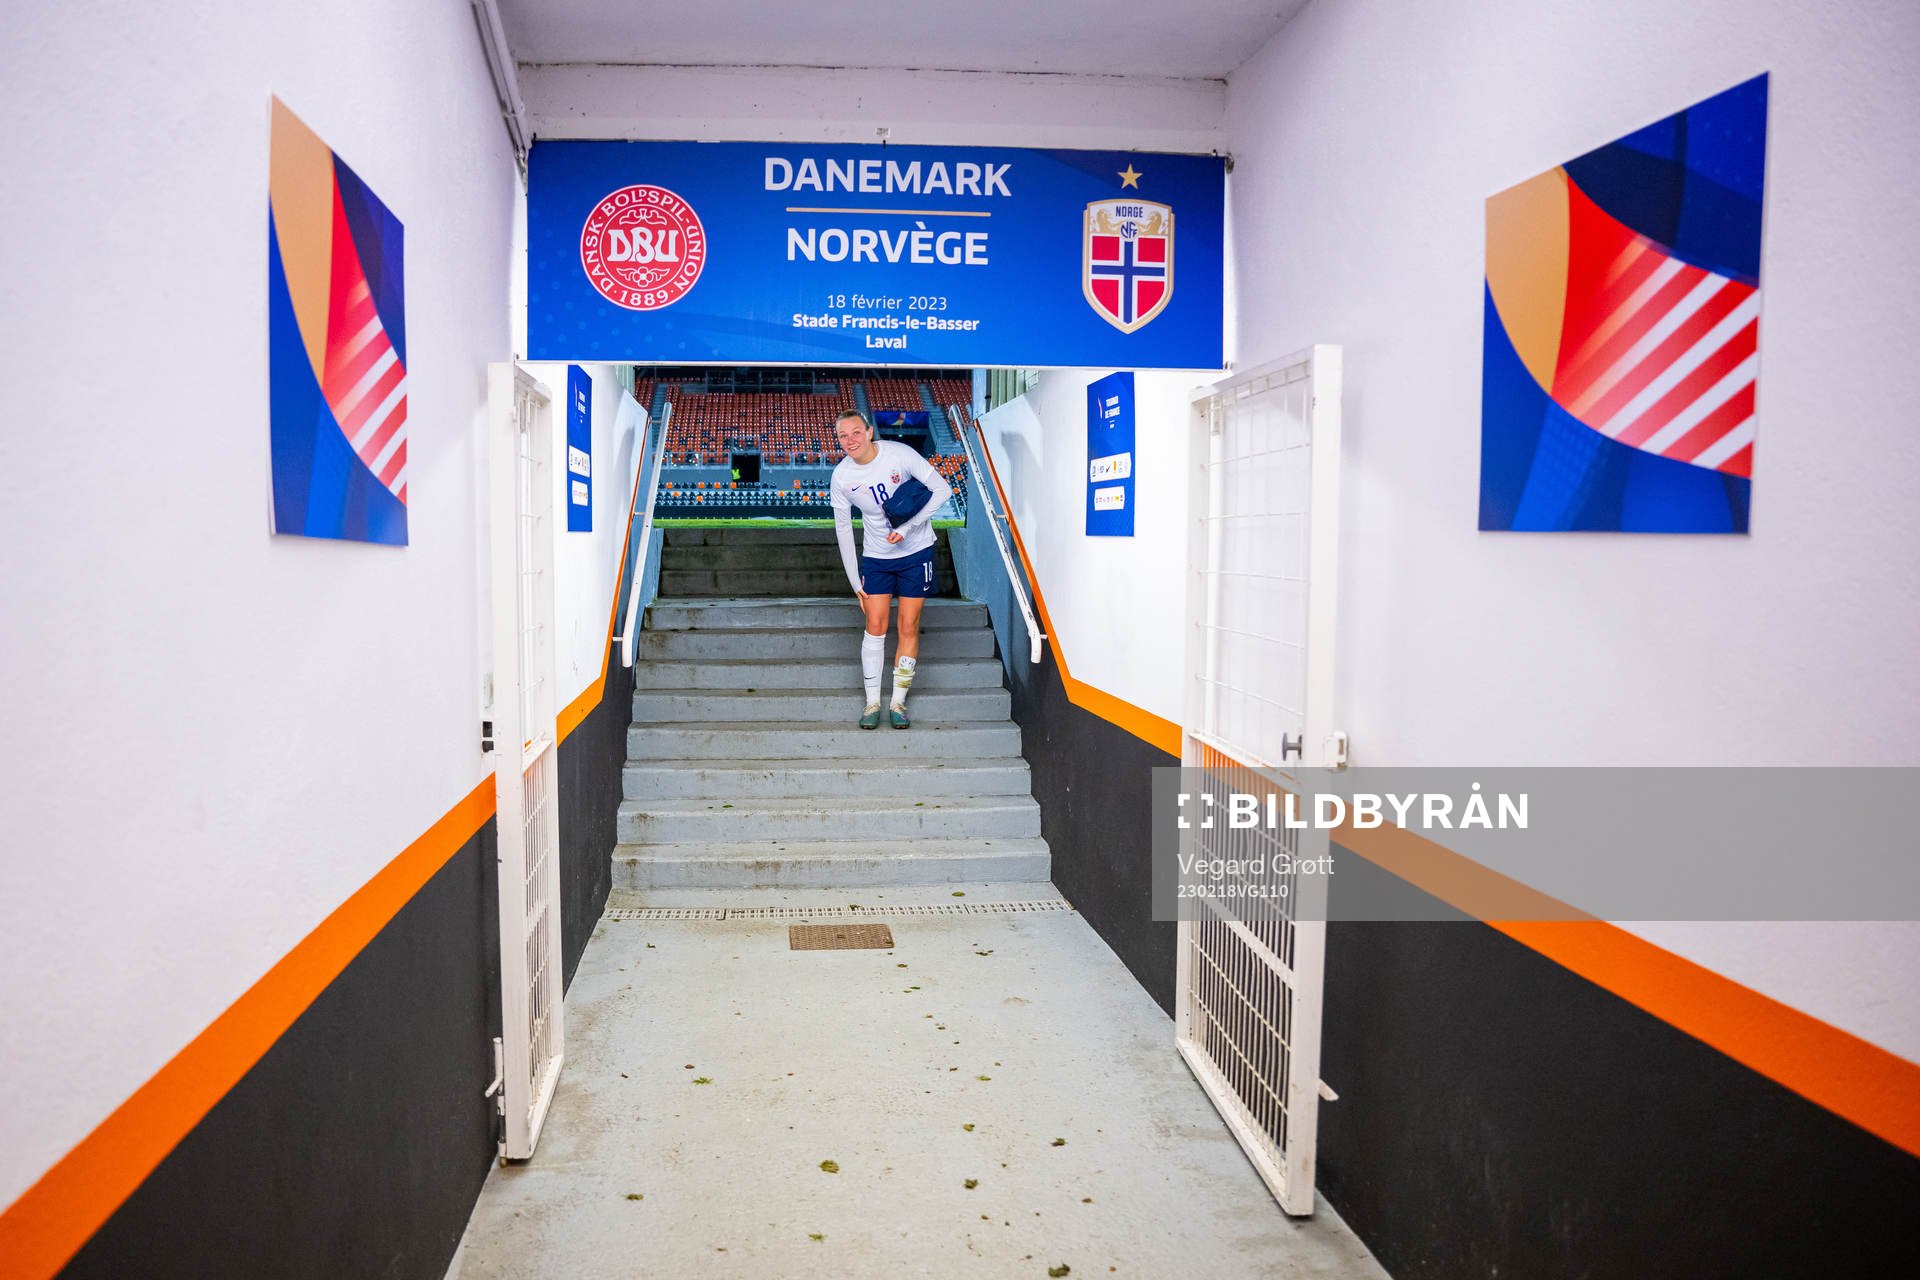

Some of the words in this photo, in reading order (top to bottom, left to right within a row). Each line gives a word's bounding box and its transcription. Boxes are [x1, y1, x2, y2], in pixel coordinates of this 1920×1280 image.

[764, 157, 1012, 197] DANEMARK
[1115, 205, 1144, 218] NORGE
[607, 227, 679, 264] DBU
[787, 221, 989, 266] NORVÈGE
[619, 289, 669, 306] 1889
[827, 295, 845, 309] 18
[851, 294, 903, 310] février
[908, 296, 947, 311] 2023
[792, 313, 838, 329] Stade
[842, 314, 980, 331] Francis-le-Basser
[866, 335, 907, 350] Laval
[868, 483, 890, 506] 18
[922, 560, 933, 583] 18
